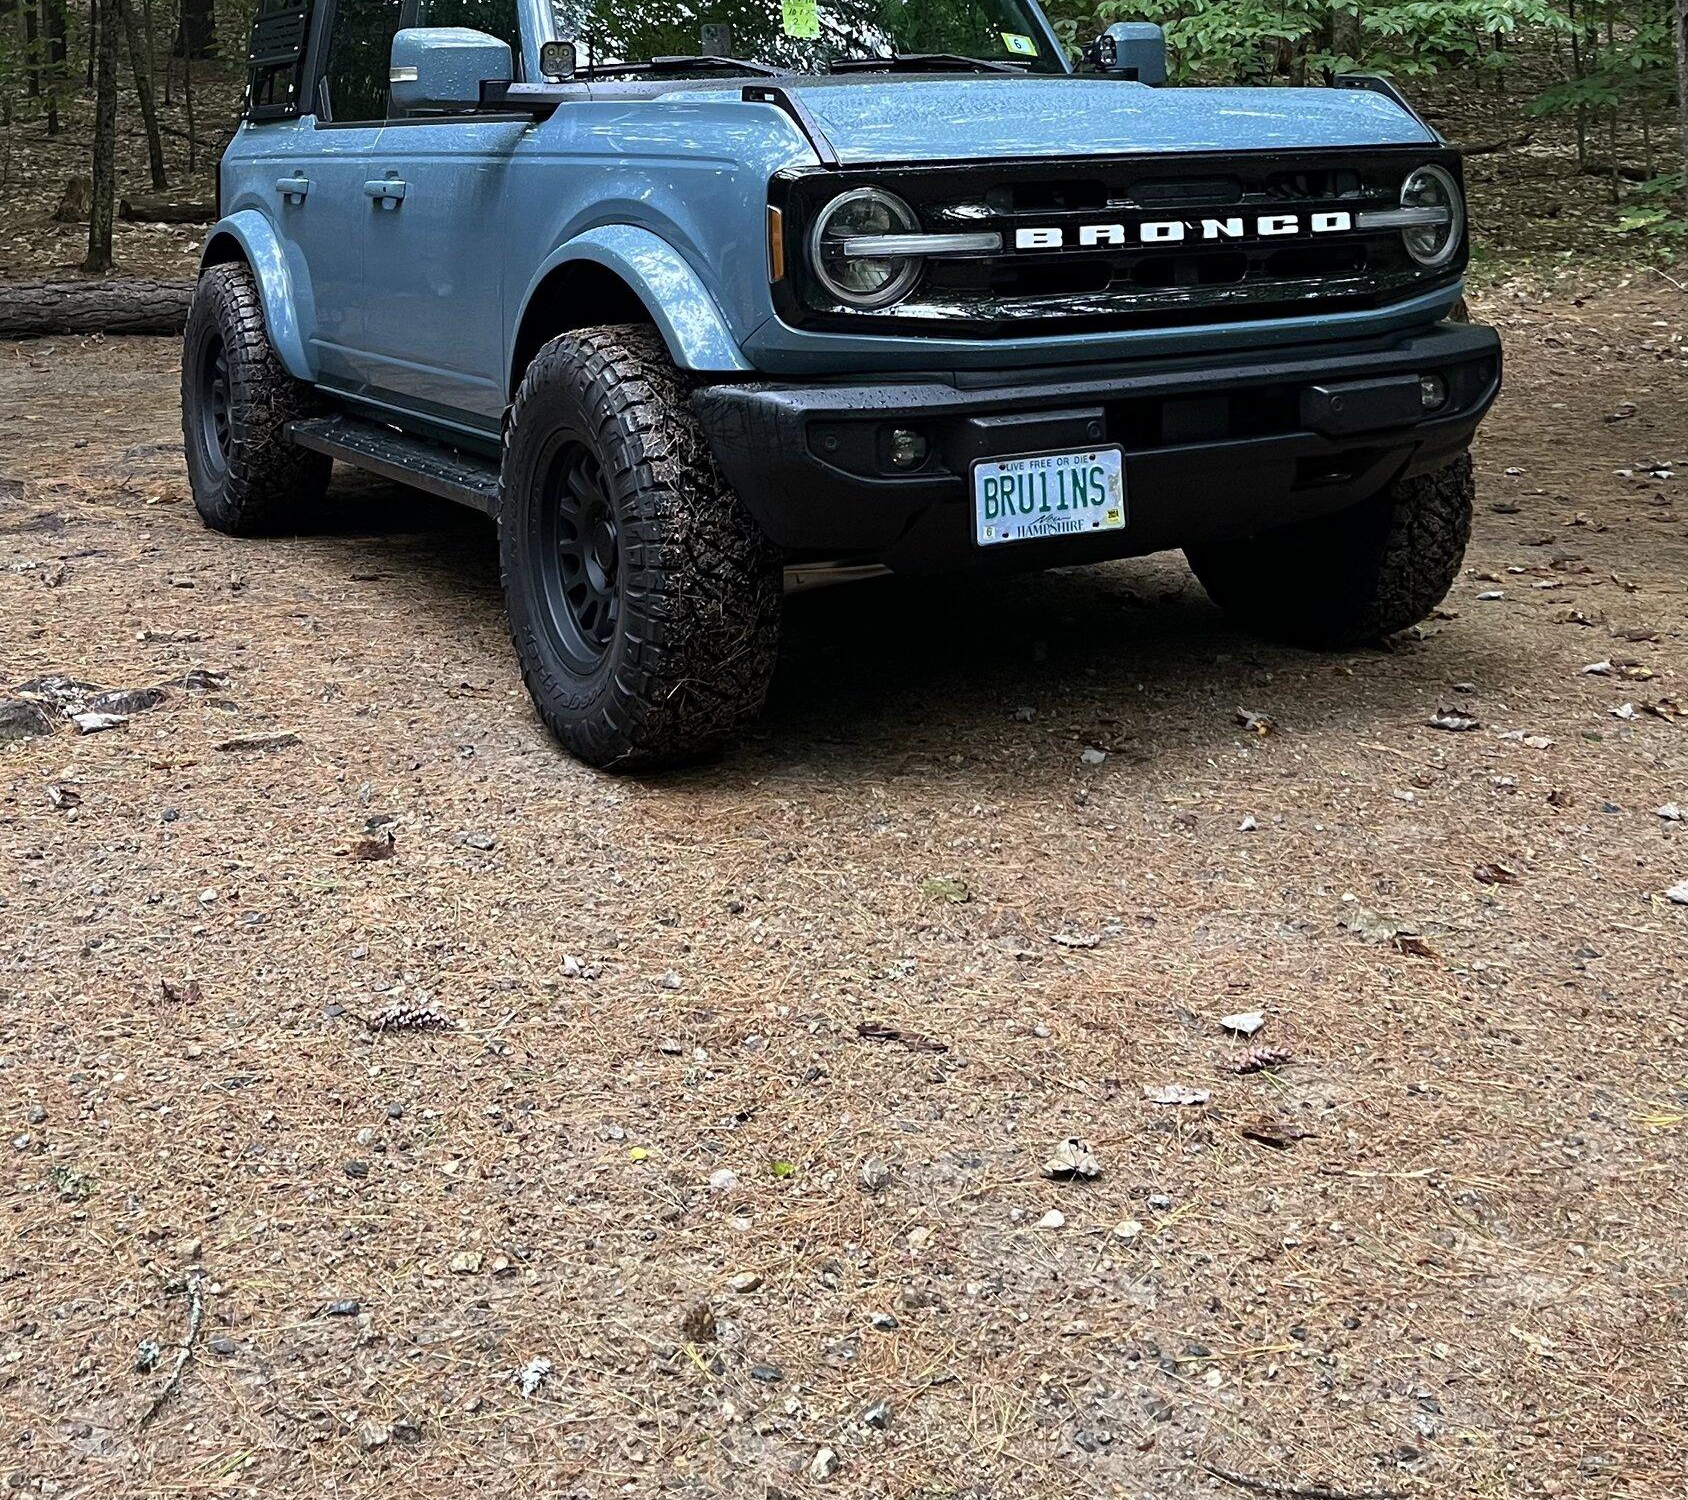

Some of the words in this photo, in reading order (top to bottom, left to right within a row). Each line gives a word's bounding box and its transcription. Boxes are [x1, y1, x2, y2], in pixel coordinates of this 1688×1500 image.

[1014, 39, 1021, 49] 6
[1015, 211, 1351, 249] BRONCO
[1006, 461, 1025, 472] LIVE
[1029, 459, 1052, 470] FREE
[1056, 456, 1070, 466] OR
[1074, 454, 1089, 465] DIE
[983, 466, 1105, 520] BRU11NS
[986, 526, 993, 537] 6
[1017, 519, 1084, 537] HAMPSHIRE
